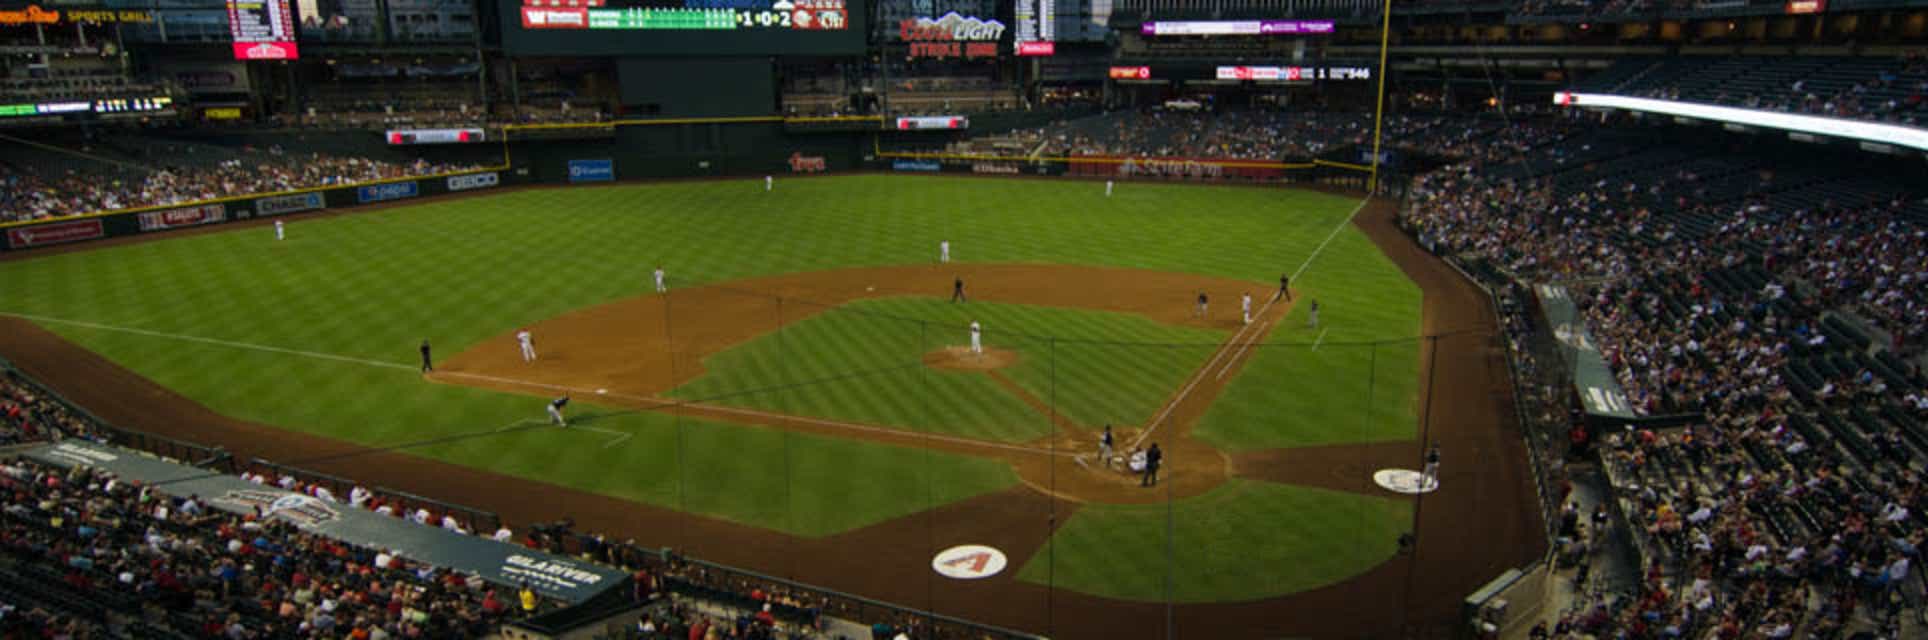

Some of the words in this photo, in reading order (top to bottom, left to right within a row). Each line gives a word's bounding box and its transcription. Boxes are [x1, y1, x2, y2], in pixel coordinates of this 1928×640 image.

[67, 10, 116, 22] SPORTS
[742, 11, 753, 26] 1
[761, 11, 772, 26] 0
[780, 11, 792, 26] 2
[953, 22, 1004, 40] LIGHT
[910, 42, 960, 57] STRIKE
